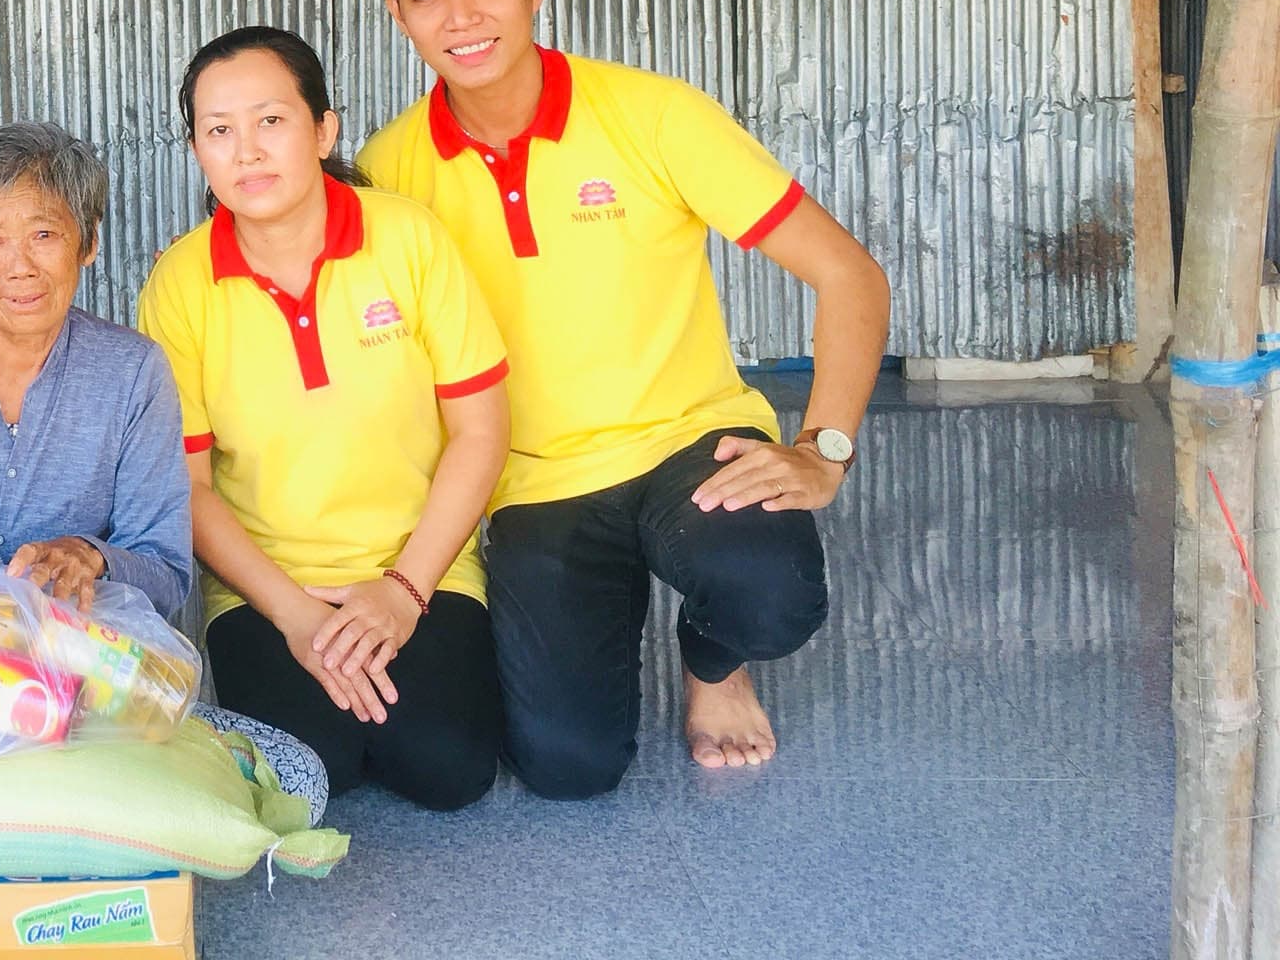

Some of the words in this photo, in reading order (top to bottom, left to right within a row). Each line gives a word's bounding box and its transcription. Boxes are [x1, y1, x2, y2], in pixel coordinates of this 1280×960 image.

[27, 924, 65, 943] Chay
[70, 914, 101, 932] Rau
[106, 899, 143, 923] Nấm
